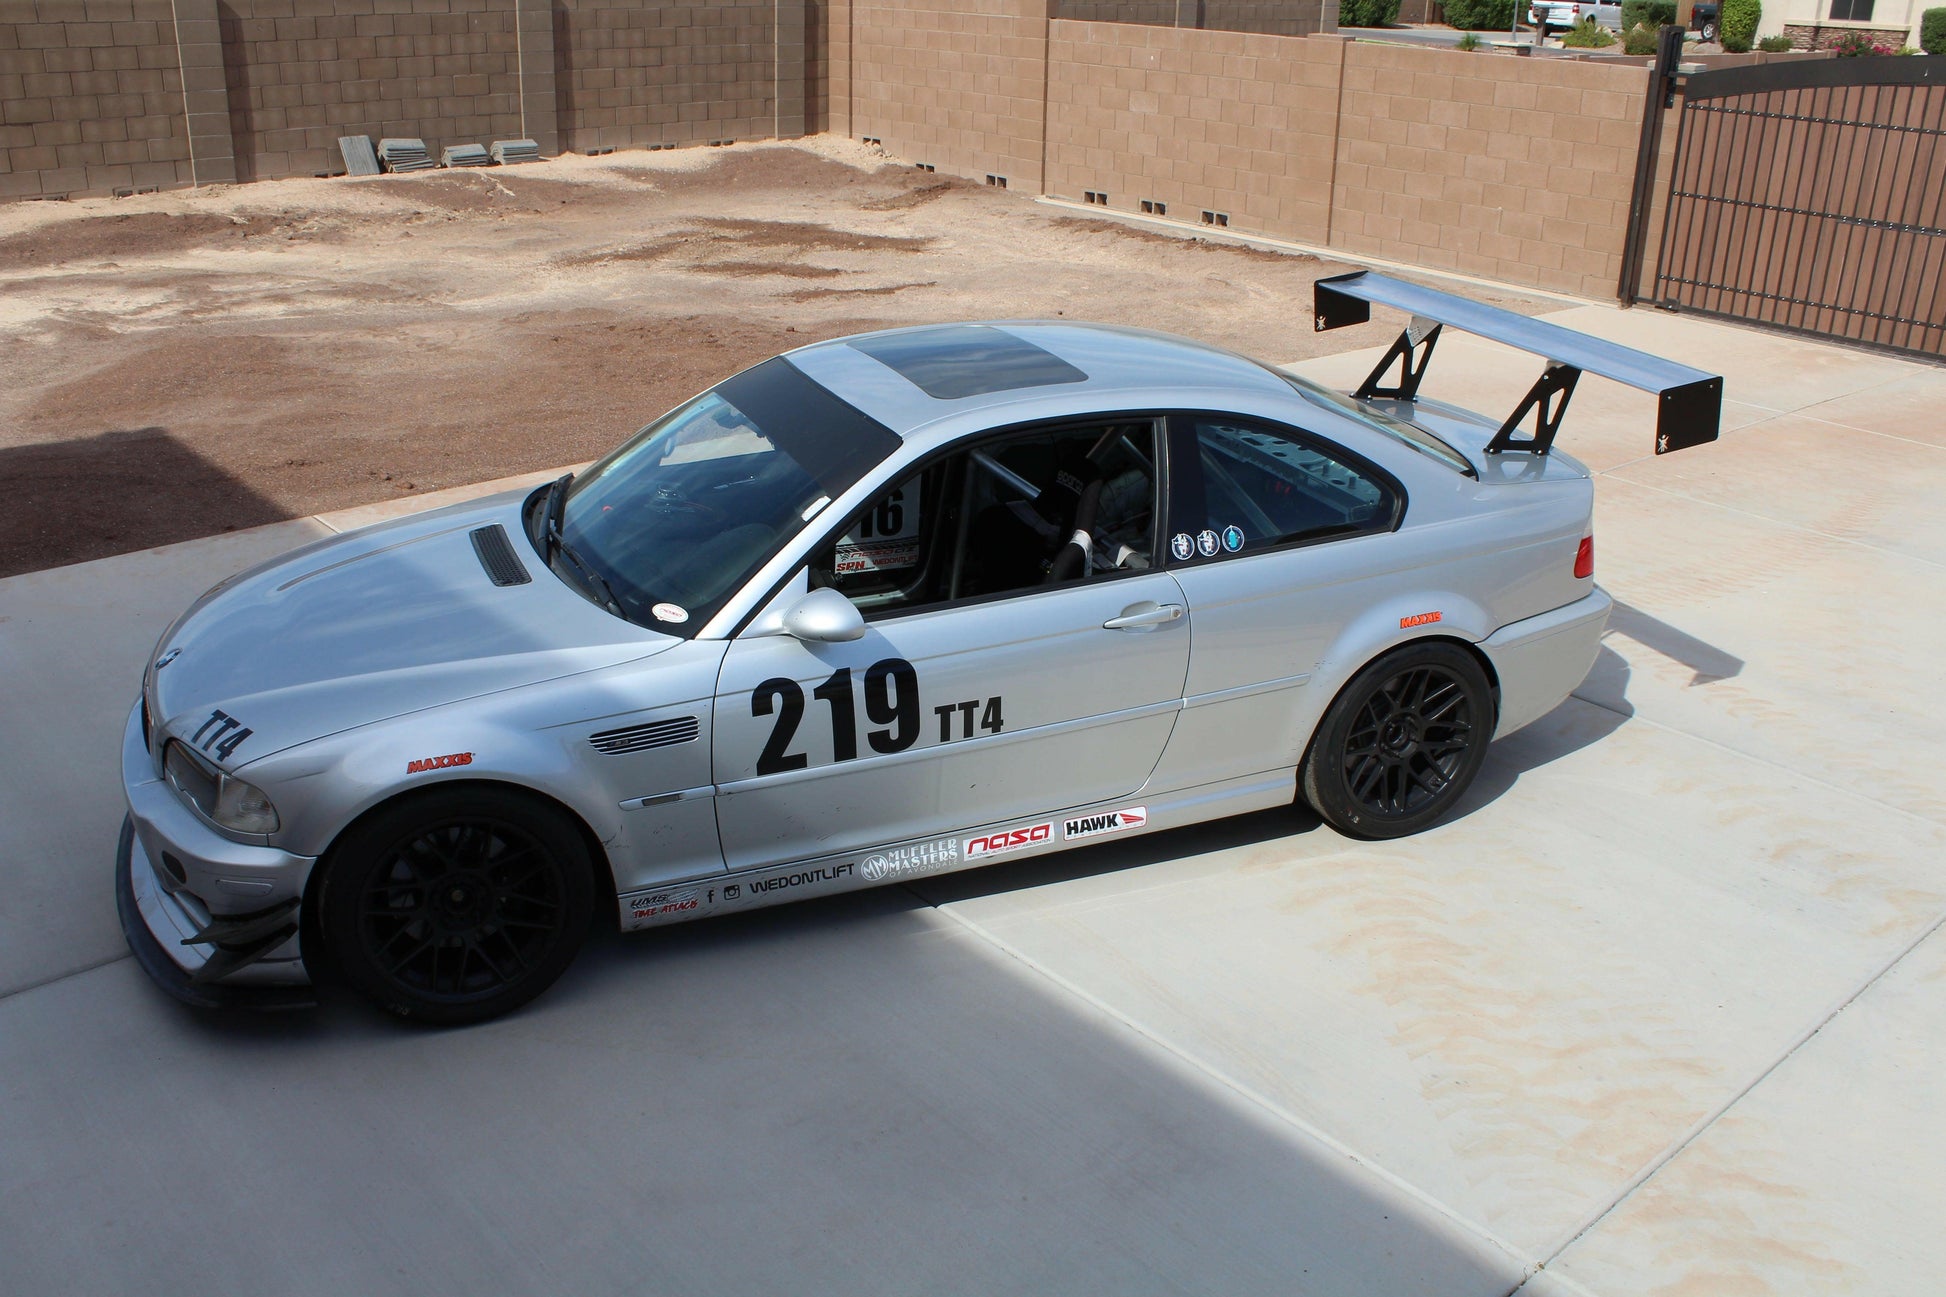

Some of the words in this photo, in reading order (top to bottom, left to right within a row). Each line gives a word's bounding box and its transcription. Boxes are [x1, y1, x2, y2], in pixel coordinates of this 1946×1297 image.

[1400, 611, 1442, 629] MAXXIS
[751, 658, 920, 776] 219
[934, 696, 1004, 742] TT4
[191, 709, 254, 762] TT4
[406, 752, 473, 775] MAXXIS
[1066, 813, 1118, 835] HAWK
[889, 839, 957, 861] MUFFLER
[967, 824, 1050, 854] nasa
[889, 848, 958, 872] MASTERS
[908, 859, 958, 874] AVONDALE
[750, 863, 854, 893] WEDONTLIFT
[633, 907, 657, 918] TIME
[661, 899, 698, 913] ATTACK
